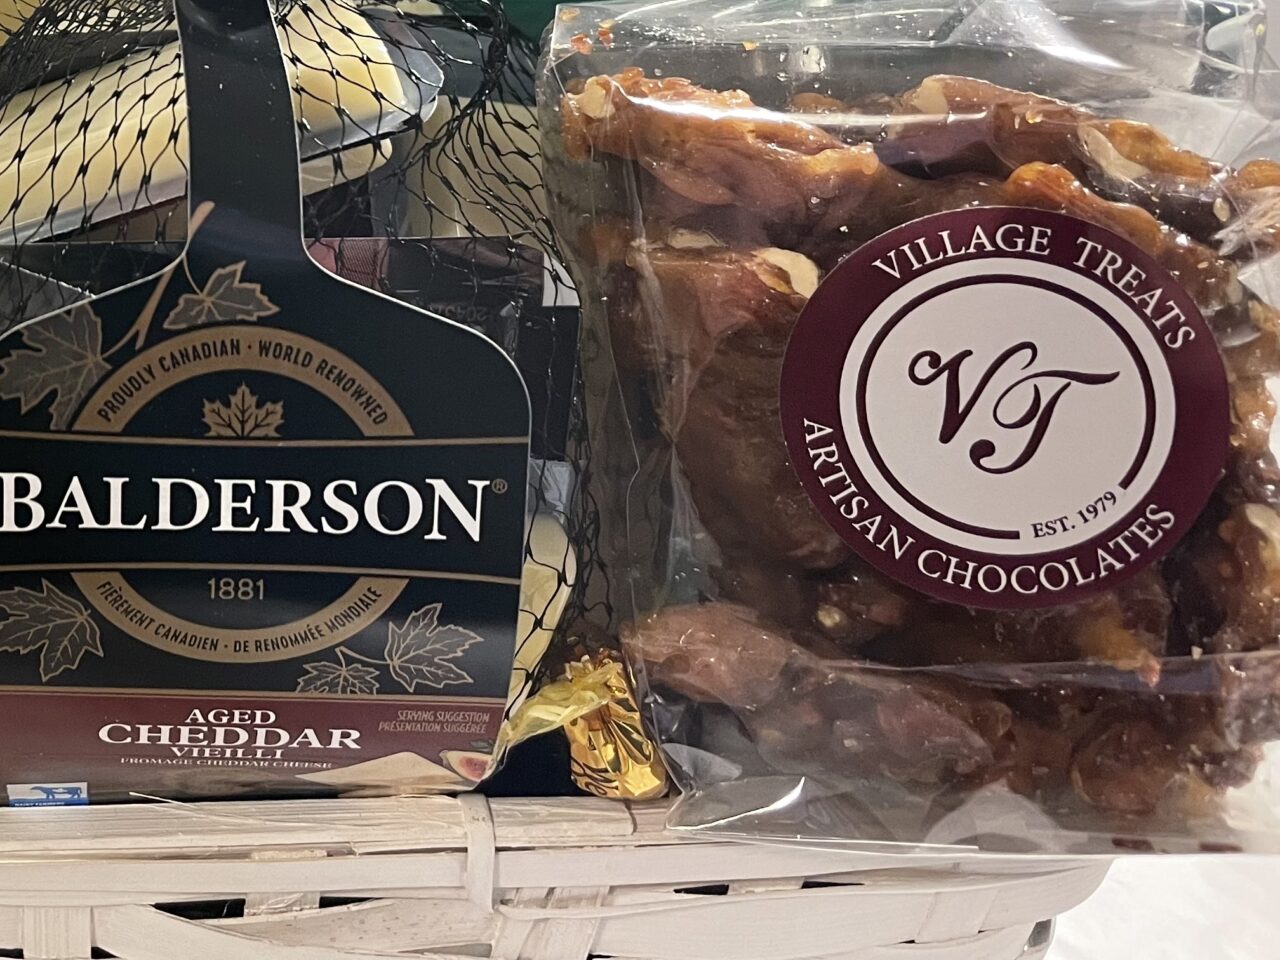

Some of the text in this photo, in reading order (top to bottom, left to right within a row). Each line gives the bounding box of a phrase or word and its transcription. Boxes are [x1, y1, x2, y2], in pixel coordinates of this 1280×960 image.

[872, 223, 1196, 351] VILLAGE TREATS
[97, 338, 389, 426] PROUDLY CANADIAN WORLD RENOWNED
[906, 340, 1121, 475] VT
[802, 417, 1176, 596] ARTISAN CHOCOLATES
[1030, 489, 1119, 540] EST. 1979
[207, 577, 265, 600] 1881
[96, 580, 383, 654] FIÈREMENT CANADIEN DE RENOMMÉE MONDIALE
[185, 708, 276, 724] AGED
[378, 720, 487, 734] PRÉSENTATION SUGGÉRÉE
[397, 709, 490, 723] SERVING SUGGESTION
[98, 723, 362, 750] CHEDDAR
[121, 757, 333, 769] FROMAGE CHEDDAR CHEESE
[169, 746, 286, 759] VIEILLI
